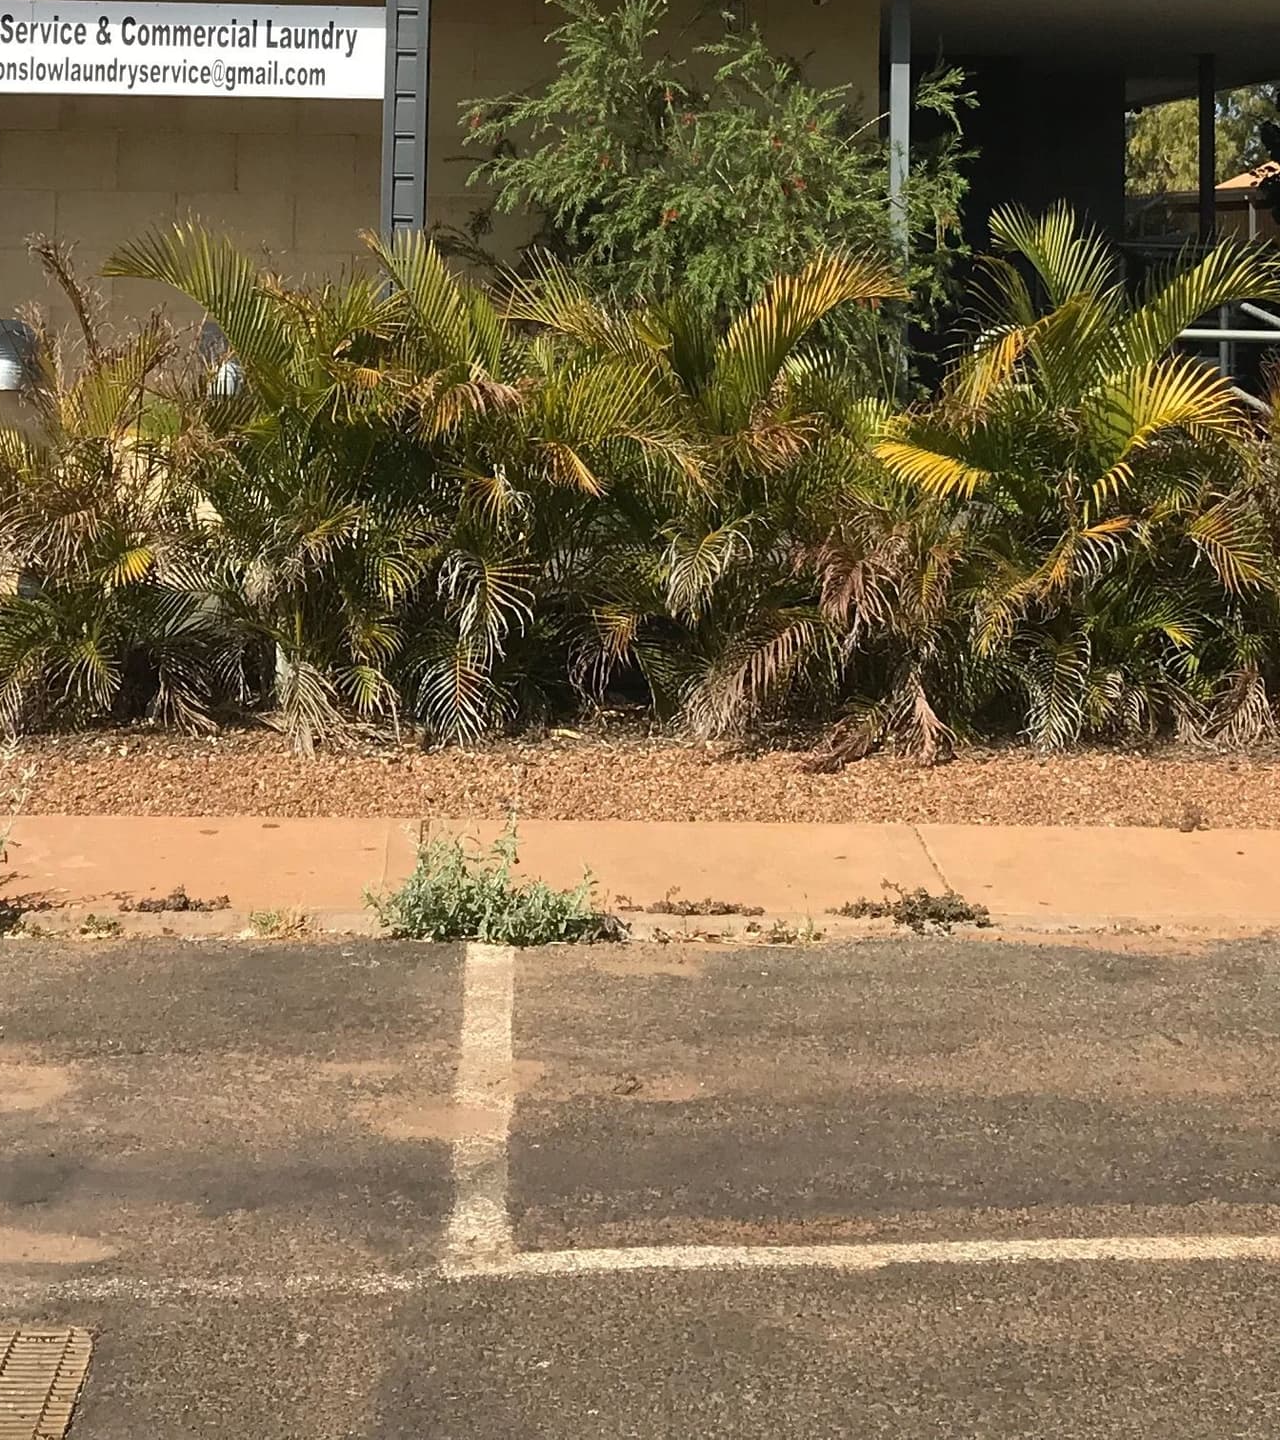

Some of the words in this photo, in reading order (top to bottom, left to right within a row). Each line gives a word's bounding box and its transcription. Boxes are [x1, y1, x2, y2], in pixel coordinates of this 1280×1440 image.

[0, 13, 88, 45] Service
[95, 15, 113, 46] &
[121, 16, 258, 49] Commercial
[266, 19, 359, 58] Laundry
